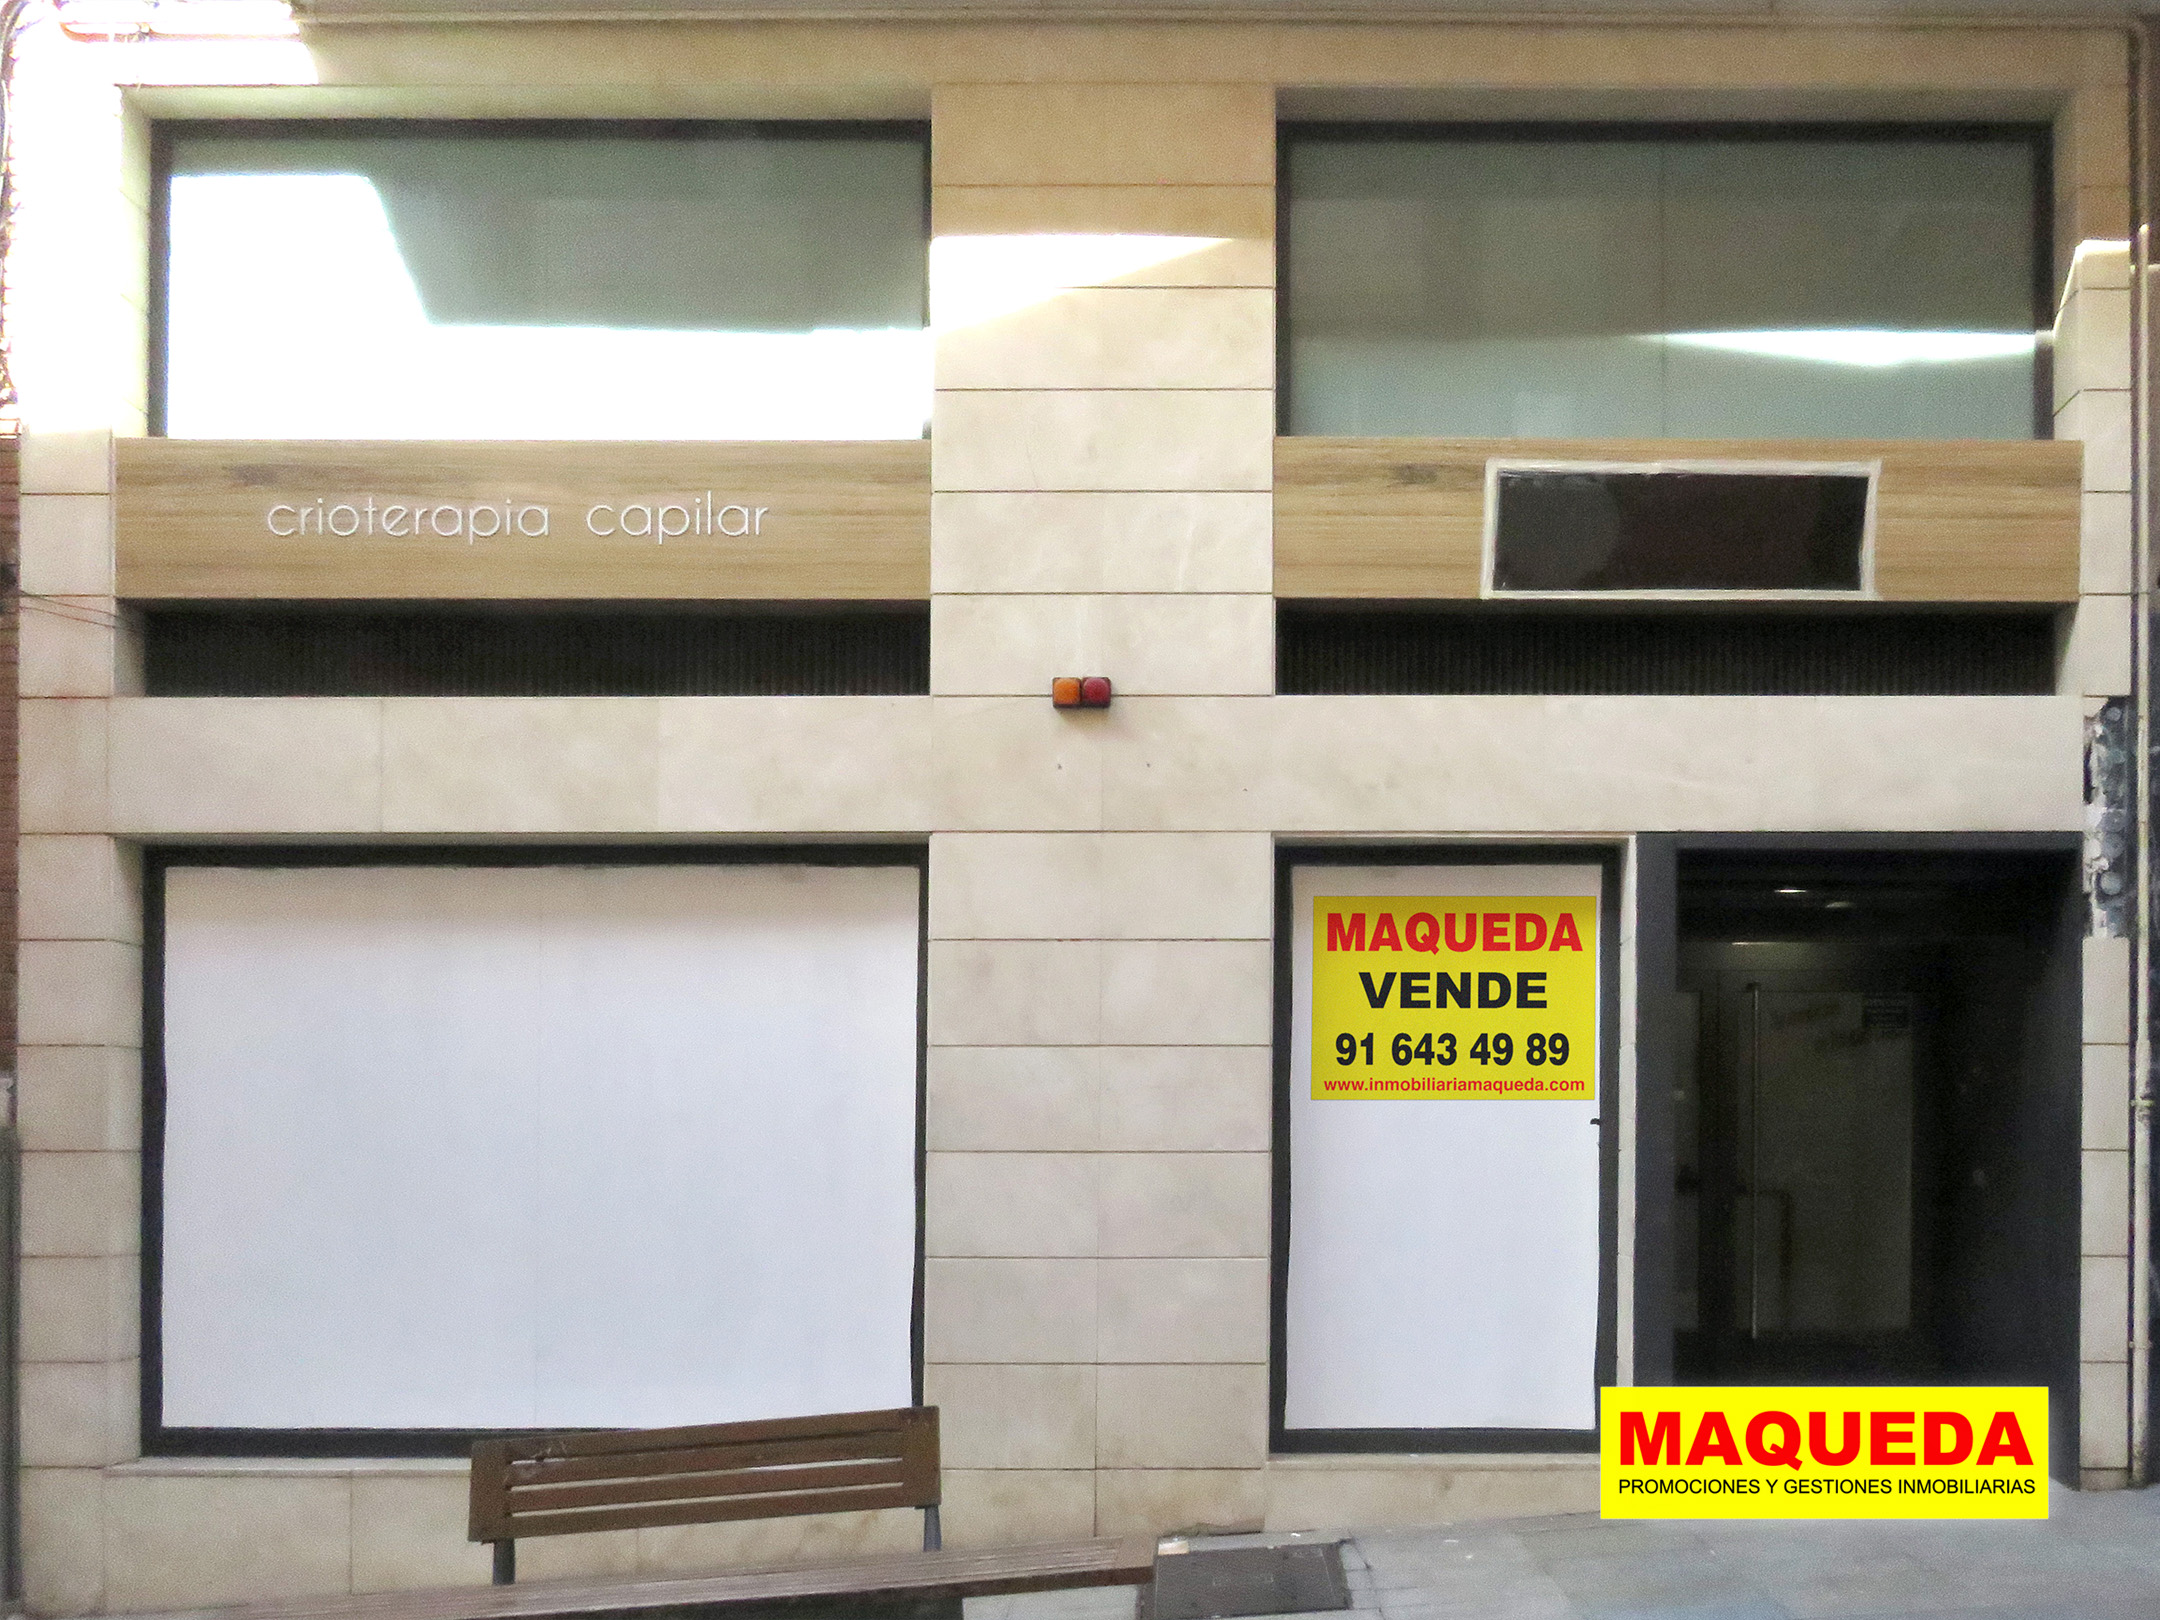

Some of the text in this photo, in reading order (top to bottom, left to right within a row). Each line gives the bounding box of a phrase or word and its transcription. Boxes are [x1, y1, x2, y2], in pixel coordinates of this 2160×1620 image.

[267, 491, 770, 544] crioterapia capilar
[1327, 912, 1583, 955] MAQUEDA
[1358, 972, 1548, 1009] VENDE
[1335, 1032, 1570, 1066] 91 643 49 89
[1324, 1077, 1585, 1095] www.inmobiliariamaqueda.com
